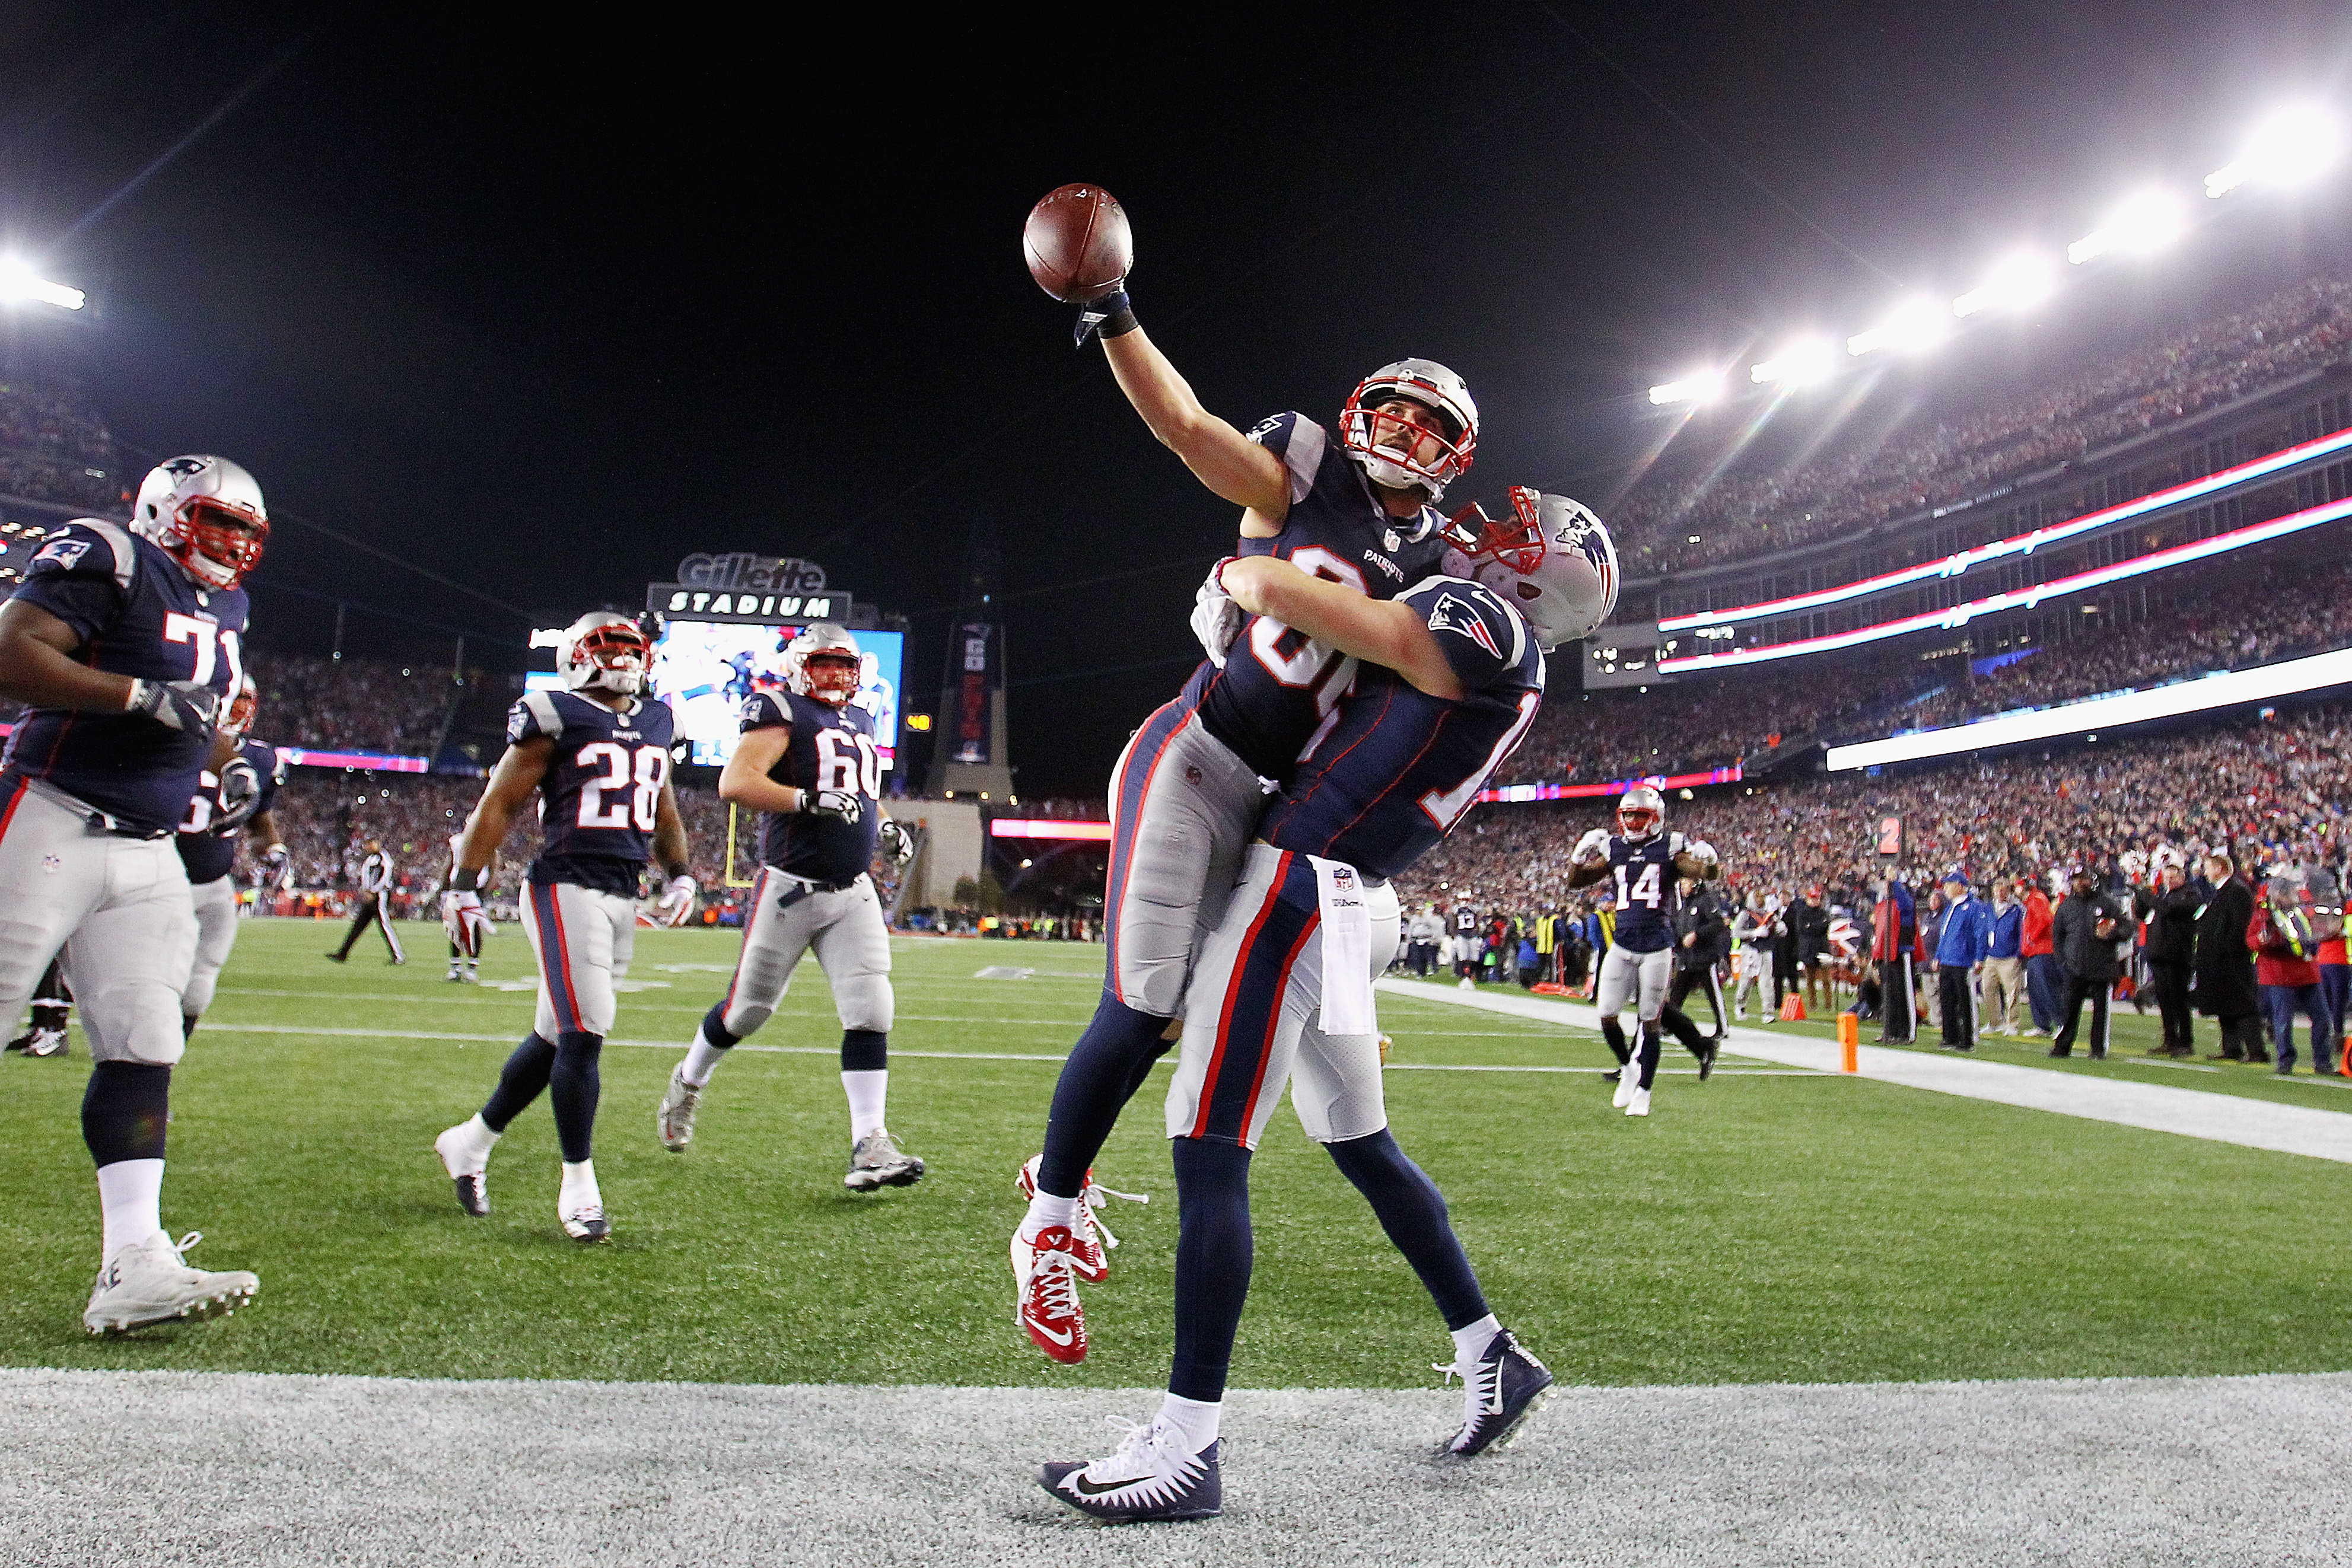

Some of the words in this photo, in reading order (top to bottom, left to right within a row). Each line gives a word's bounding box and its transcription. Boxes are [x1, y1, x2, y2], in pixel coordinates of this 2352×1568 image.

[678, 552, 826, 592] Gillette
[1363, 549, 1405, 583] PATRIOTS
[669, 591, 830, 618] STADIUM
[163, 610, 243, 731] 71
[575, 741, 670, 832] 28
[814, 727, 881, 800] 60
[1417, 690, 1542, 837] 1
[1879, 817, 1901, 854] 2
[1613, 863, 1662, 911] 14
